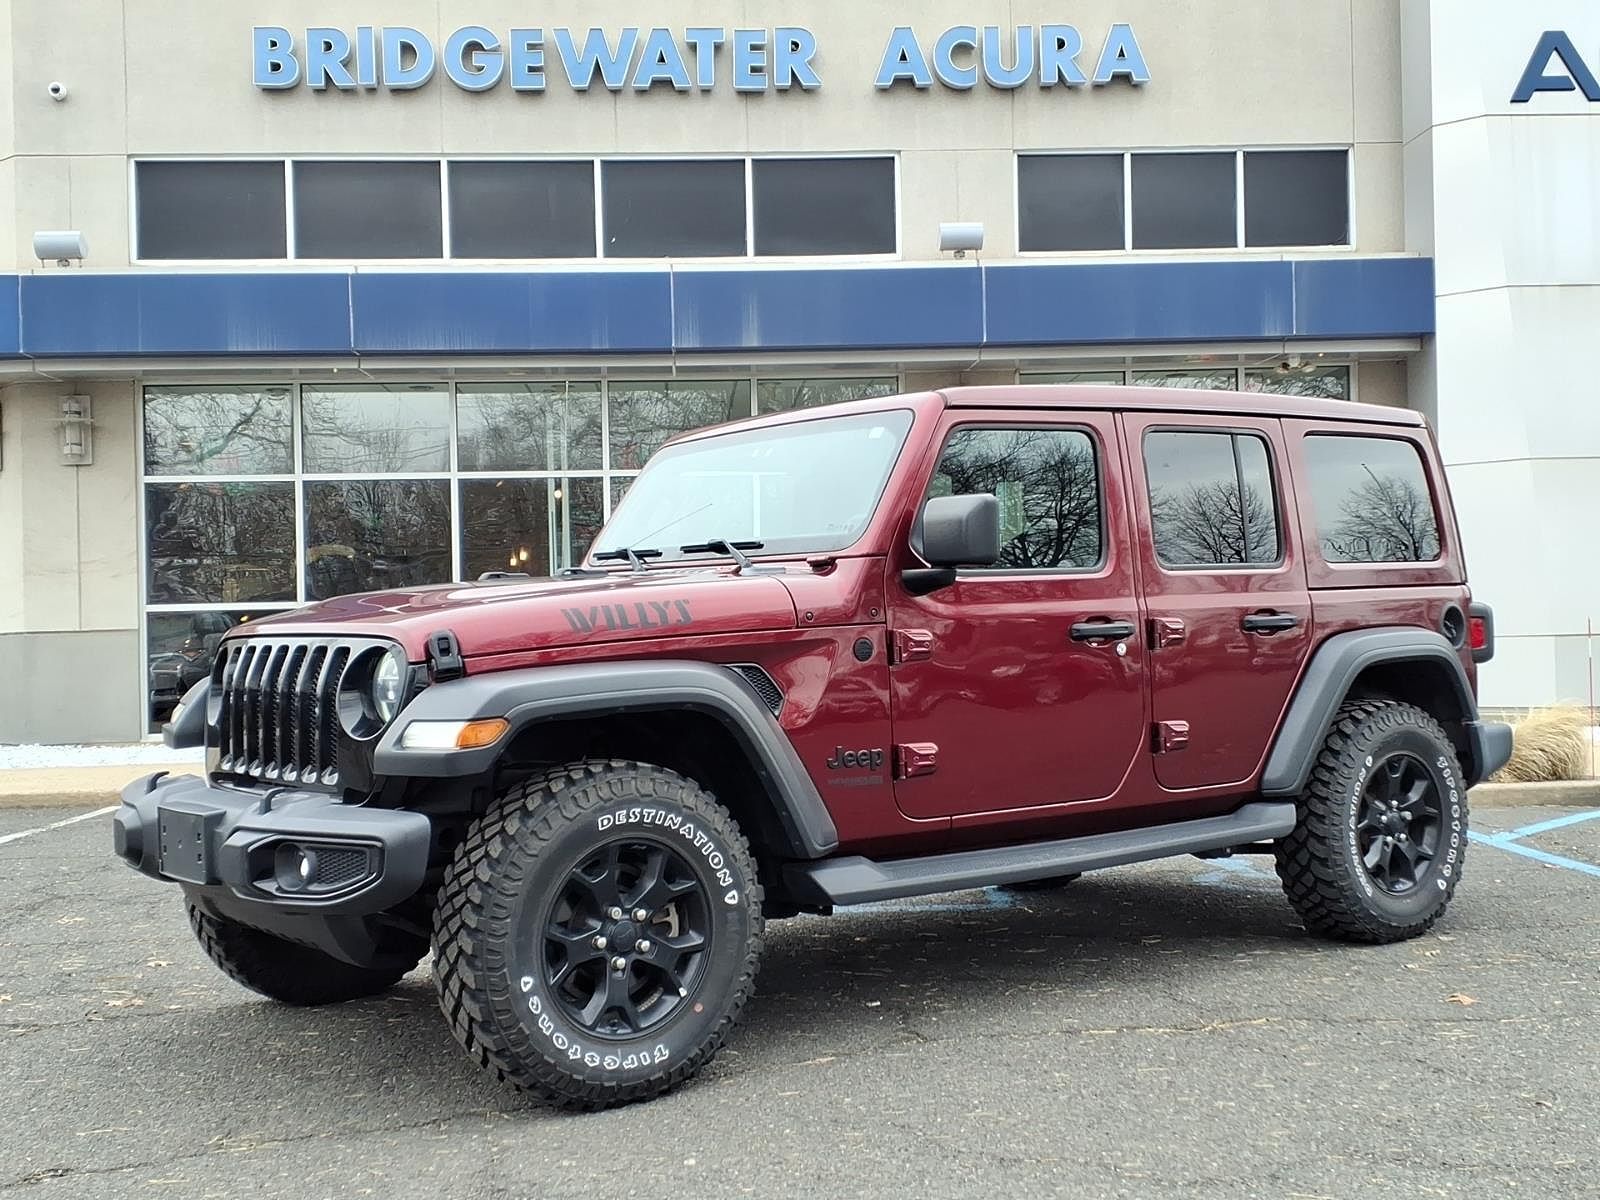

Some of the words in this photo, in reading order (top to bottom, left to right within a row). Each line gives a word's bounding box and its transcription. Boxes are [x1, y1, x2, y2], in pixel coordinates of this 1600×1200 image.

[251, 25, 823, 92] BRIDGEWATER
[873, 23, 1152, 90] ACURA
[560, 599, 693, 633] WILLYS
[827, 745, 884, 771] Jeep
[597, 808, 733, 887] DESTINATION
[528, 996, 669, 1070] Firestone
